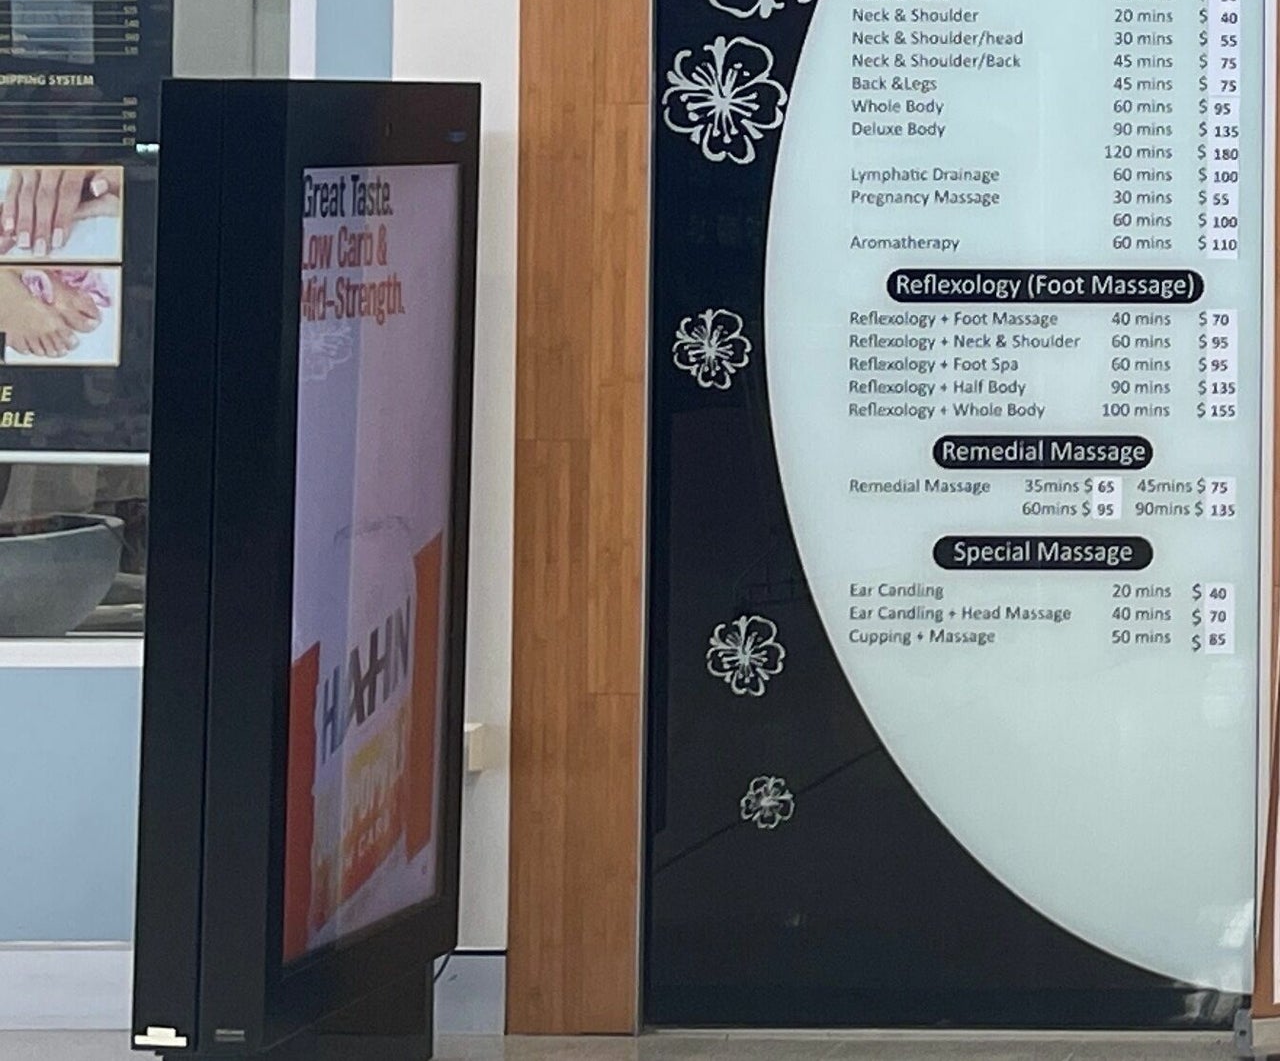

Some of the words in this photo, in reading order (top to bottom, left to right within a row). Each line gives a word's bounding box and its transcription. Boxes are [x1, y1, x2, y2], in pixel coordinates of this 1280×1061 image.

[853, 8, 889, 22] Neck
[894, 8, 906, 22] &
[911, 8, 979, 22] Shoulder
[852, 54, 889, 67] Neck
[894, 54, 906, 67] &
[911, 53, 1020, 69] Shoulder/Back
[49, 74, 94, 86] SYSTEM
[852, 76, 886, 90] Back
[852, 99, 900, 113] Whole
[906, 99, 944, 116] Body
[852, 122, 902, 135] Deluxe
[908, 122, 945, 138] Body
[852, 167, 928, 185] Lymphatic
[933, 167, 1000, 184] Drainage
[302, 174, 346, 219] Great
[852, 190, 929, 207] Pregnancy
[935, 190, 1000, 207] Massage
[338, 224, 373, 268] Carb
[850, 236, 960, 252] Aromatherapy
[897, 274, 1021, 298] Reflexology
[1027, 274, 1085, 298] (Foot
[1092, 274, 1194, 298] Massage)
[849, 402, 935, 420] Reflexology
[953, 402, 1002, 417] Whole
[1008, 402, 1045, 419] Body
[942, 440, 1043, 463] Remedial
[1051, 440, 1146, 465] Massage
[954, 541, 1030, 565] Special
[1037, 541, 1133, 565] Massage
[850, 584, 872, 597] Ear
[878, 583, 944, 600] Candling
[849, 629, 911, 646] Cupping
[930, 629, 996, 646] Massage
[321, 595, 411, 765] HAHN
